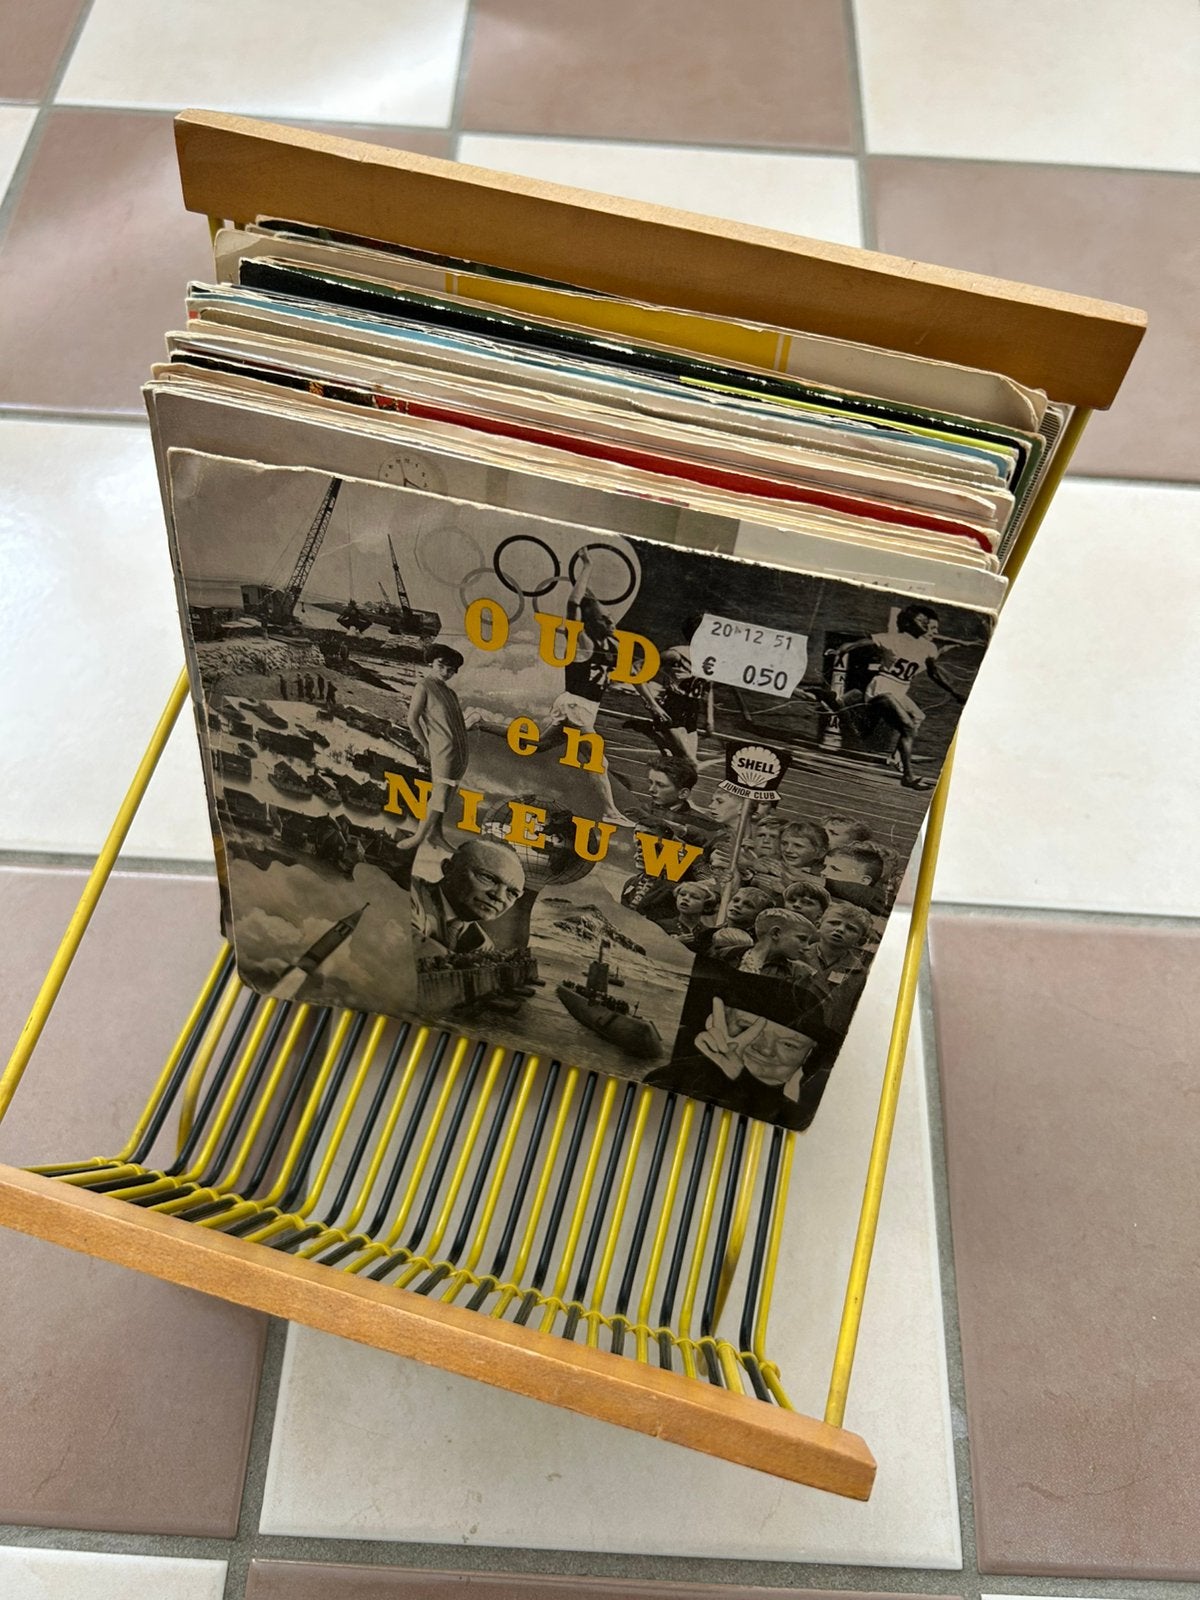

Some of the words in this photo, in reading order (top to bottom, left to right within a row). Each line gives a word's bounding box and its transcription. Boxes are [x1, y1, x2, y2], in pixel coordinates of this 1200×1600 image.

[464, 598, 661, 685] OUD
[711, 622, 733, 637] 20
[745, 628, 764, 644] 12
[773, 634, 792, 650] 51
[507, 716, 605, 774] en
[737, 757, 775, 774] SHELL
[723, 782, 751, 797] JUNIOR
[383, 771, 704, 882] NIEUW
